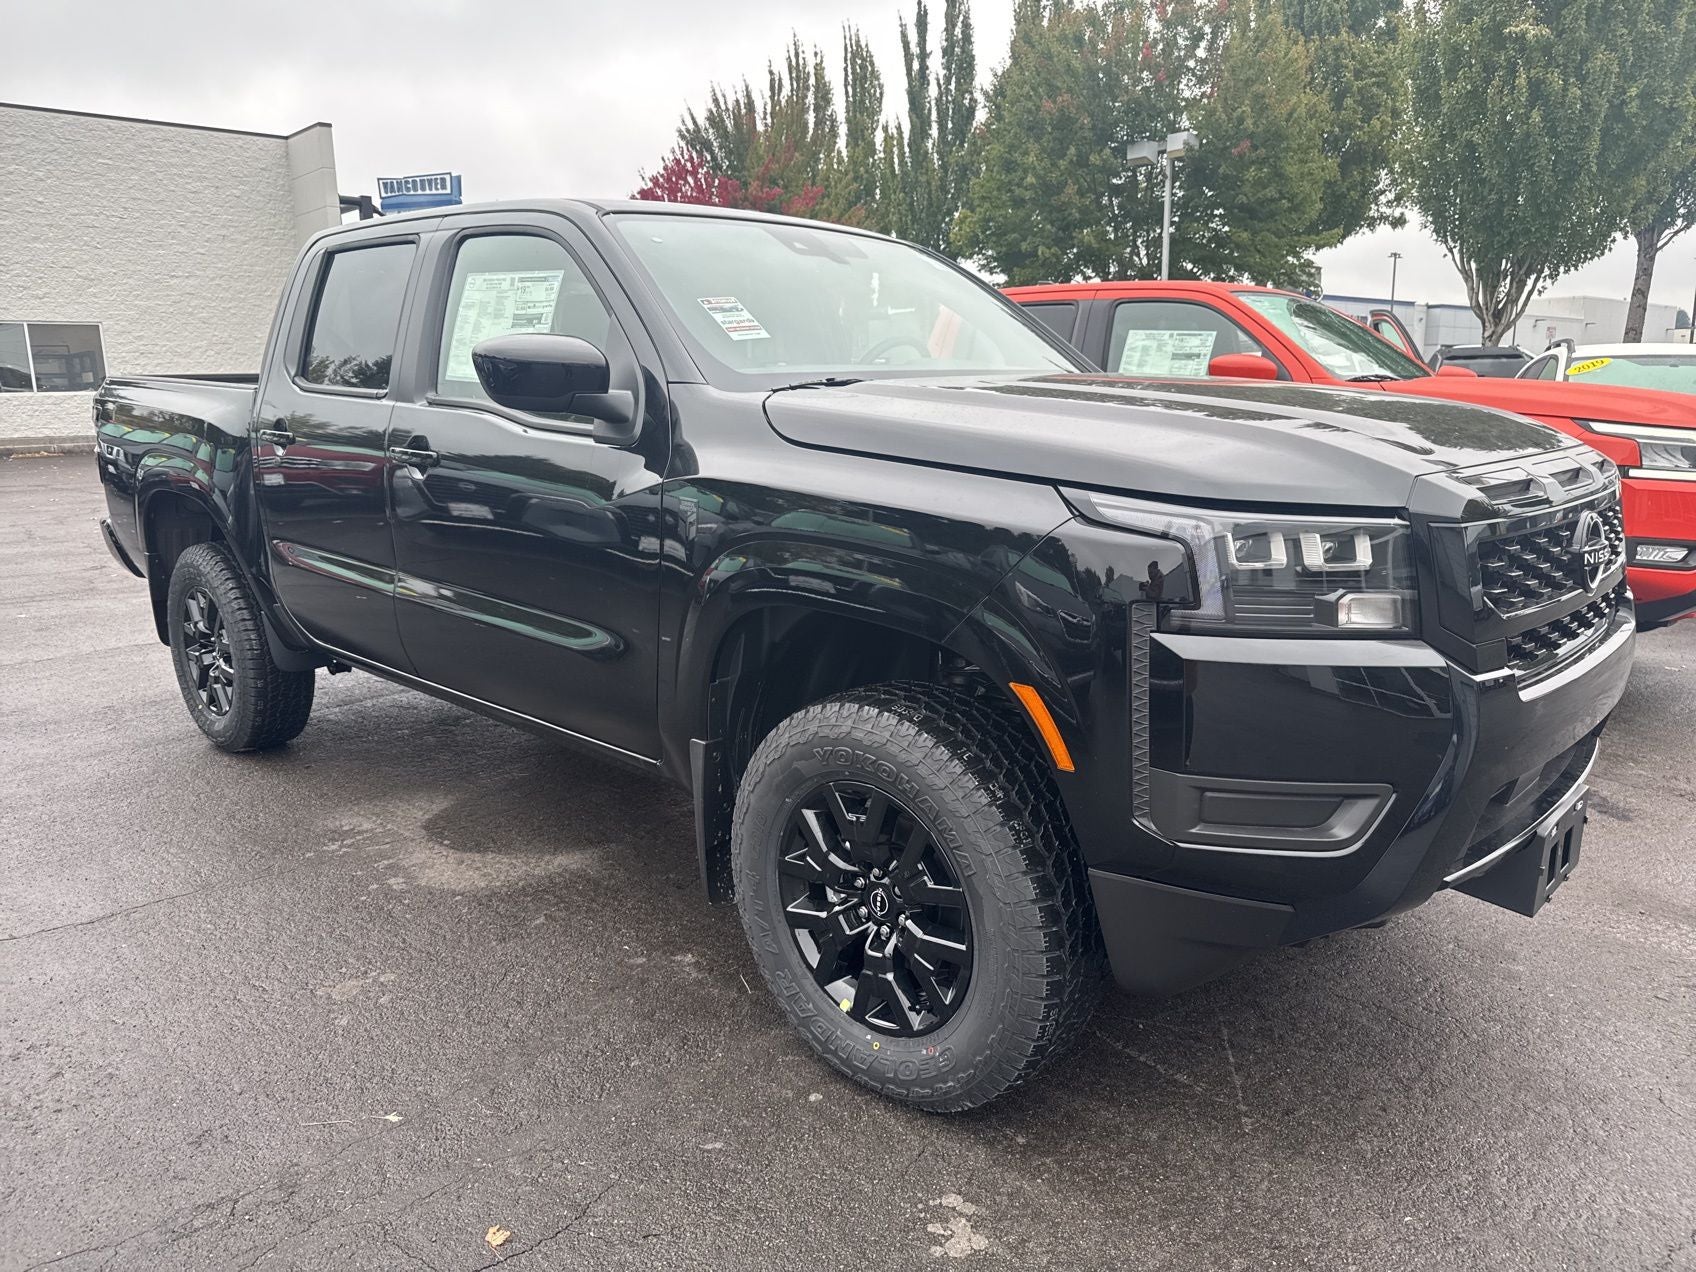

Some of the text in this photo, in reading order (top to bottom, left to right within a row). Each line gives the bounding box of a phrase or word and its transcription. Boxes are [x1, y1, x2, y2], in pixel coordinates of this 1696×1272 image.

[382, 177, 448, 194] VANCOUVER
[1574, 360, 1604, 373] 2019
[814, 746, 976, 877] YOKOHAMA
[776, 970, 957, 1082] GEOLANDAR
